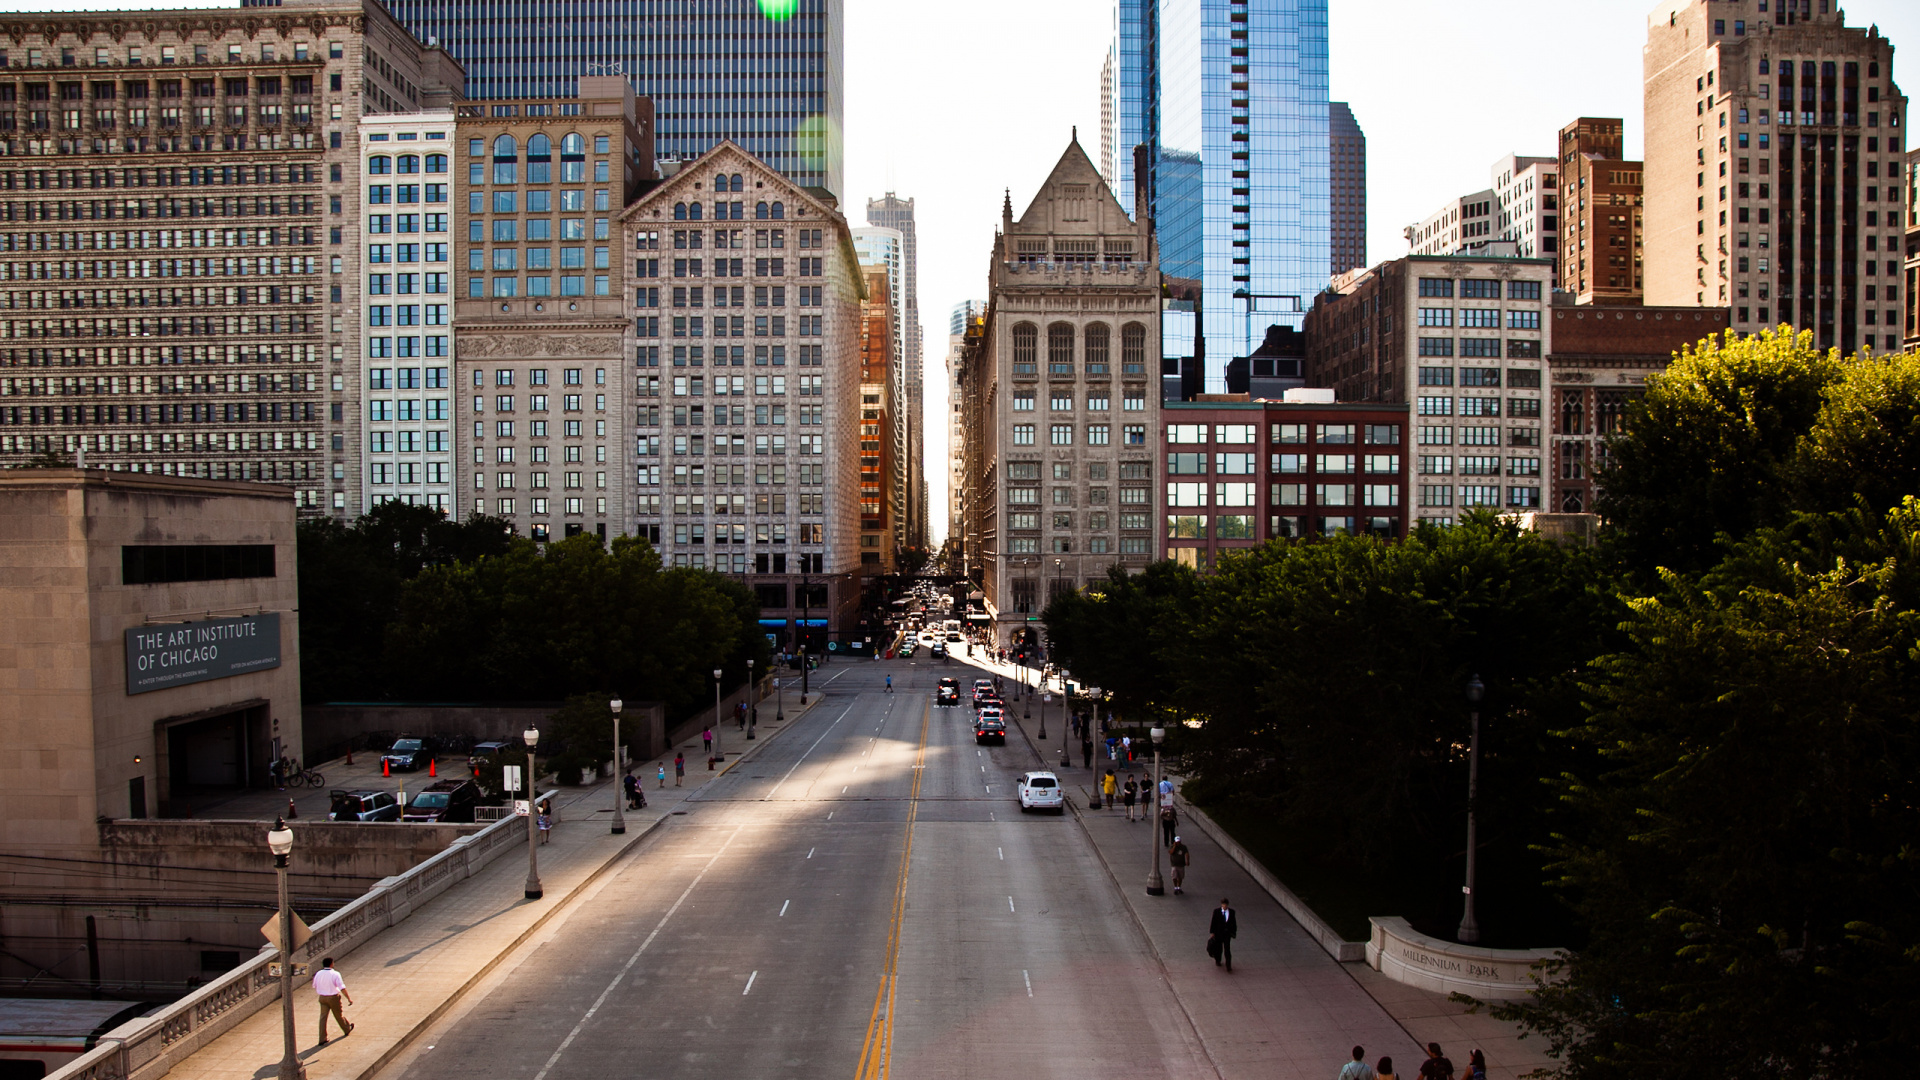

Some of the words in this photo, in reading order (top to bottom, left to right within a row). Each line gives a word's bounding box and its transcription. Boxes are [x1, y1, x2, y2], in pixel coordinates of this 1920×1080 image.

[137, 632, 163, 650] THE
[168, 629, 192, 646] ART
[197, 622, 257, 643] INSTITUTE
[137, 653, 155, 671] OF
[160, 645, 218, 668] CHICAGO
[142, 677, 155, 685] ENTER
[155, 674, 174, 682] THROUGH
[1402, 948, 1461, 972] MILLENNIUM
[1469, 963, 1499, 978] PARK
